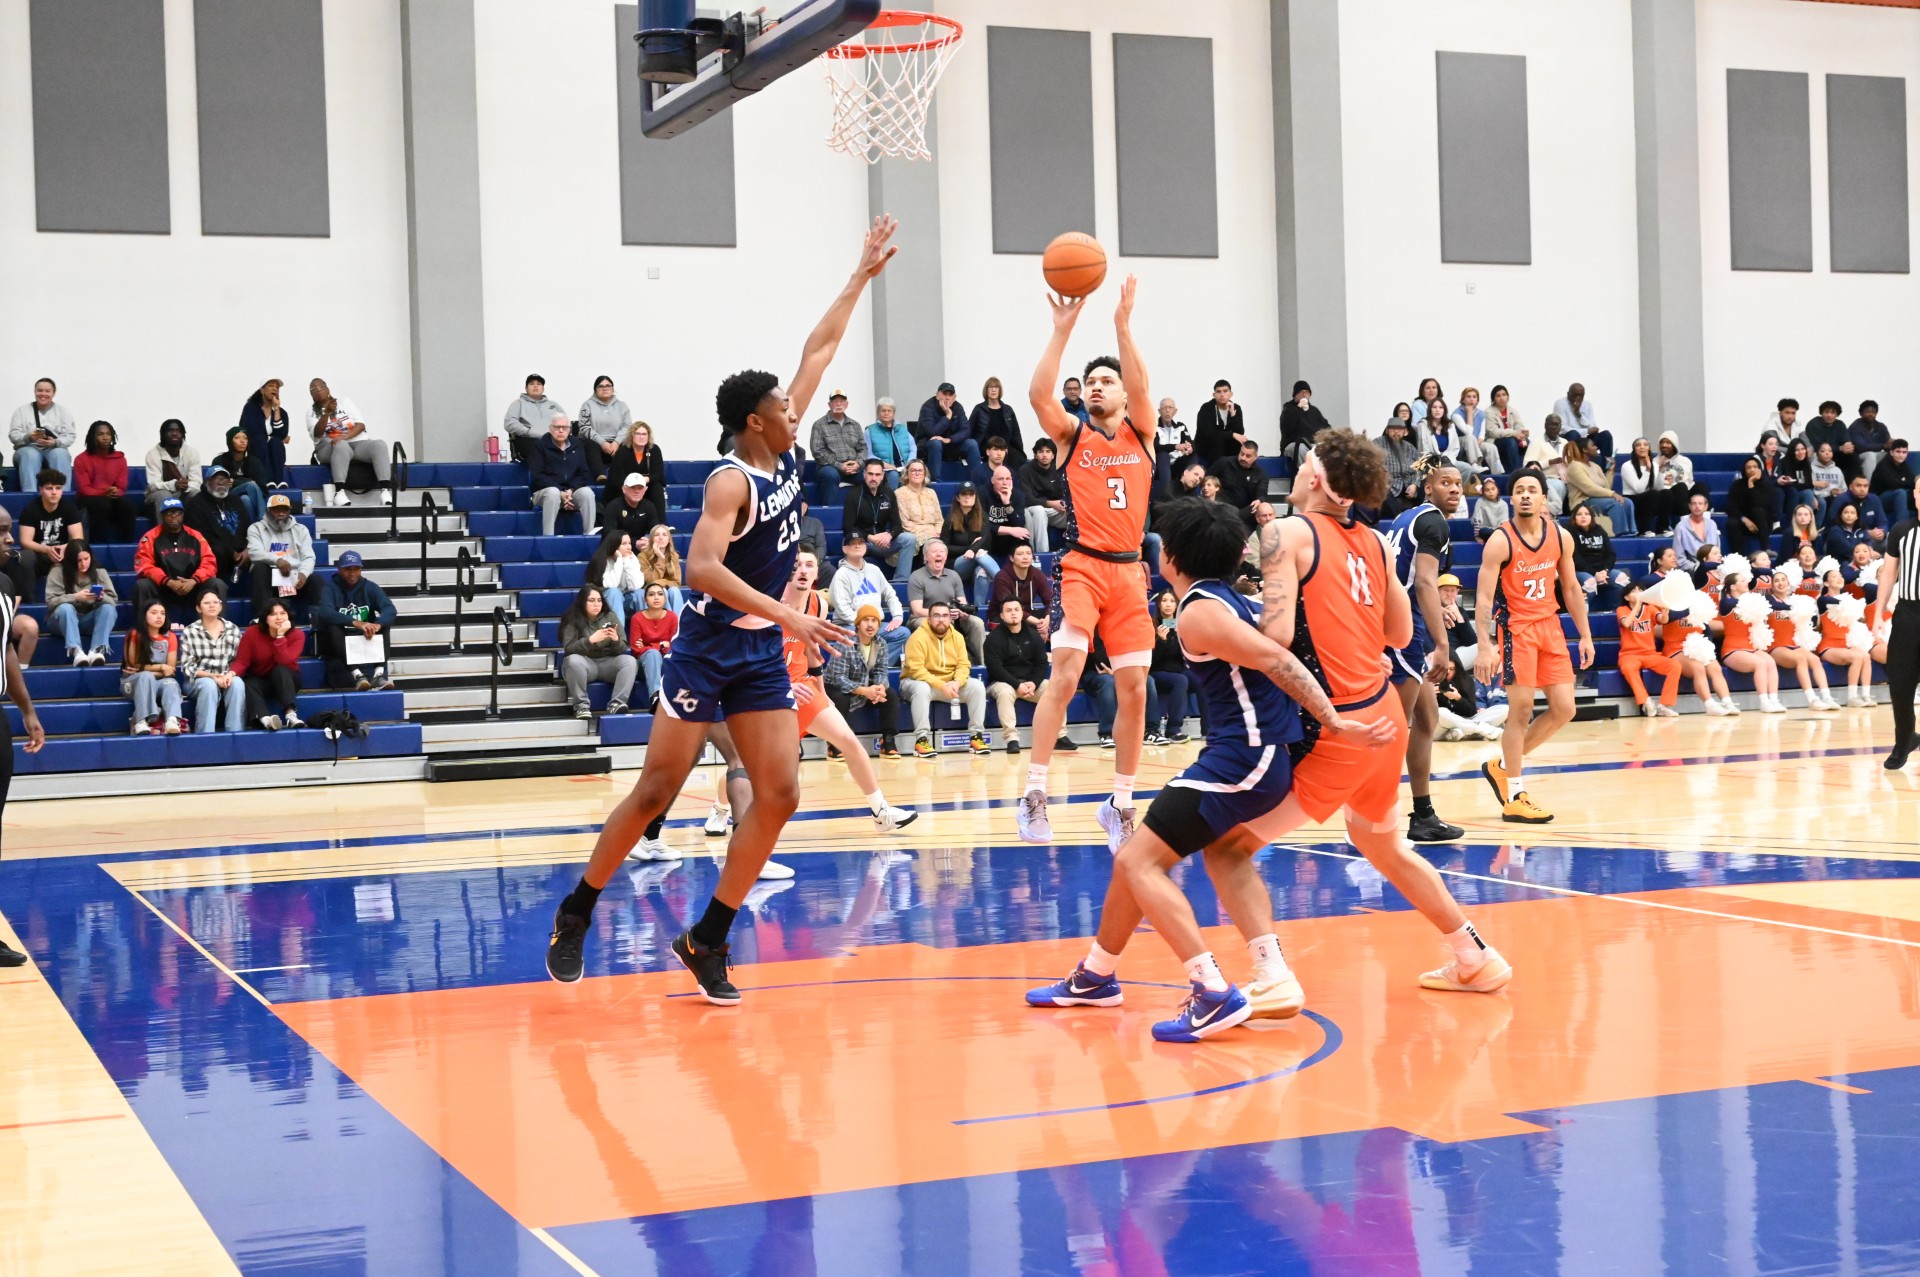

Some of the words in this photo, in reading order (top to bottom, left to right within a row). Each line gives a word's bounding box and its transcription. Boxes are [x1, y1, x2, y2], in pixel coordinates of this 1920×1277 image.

[1079, 449, 1141, 471] Sequoias
[1106, 476, 1127, 510] 3
[777, 510, 801, 552] 23
[270, 542, 289, 552] NIKE
[1346, 551, 1374, 606] 11
[1523, 577, 1546, 600] 23
[1630, 620, 1651, 632] IANT
